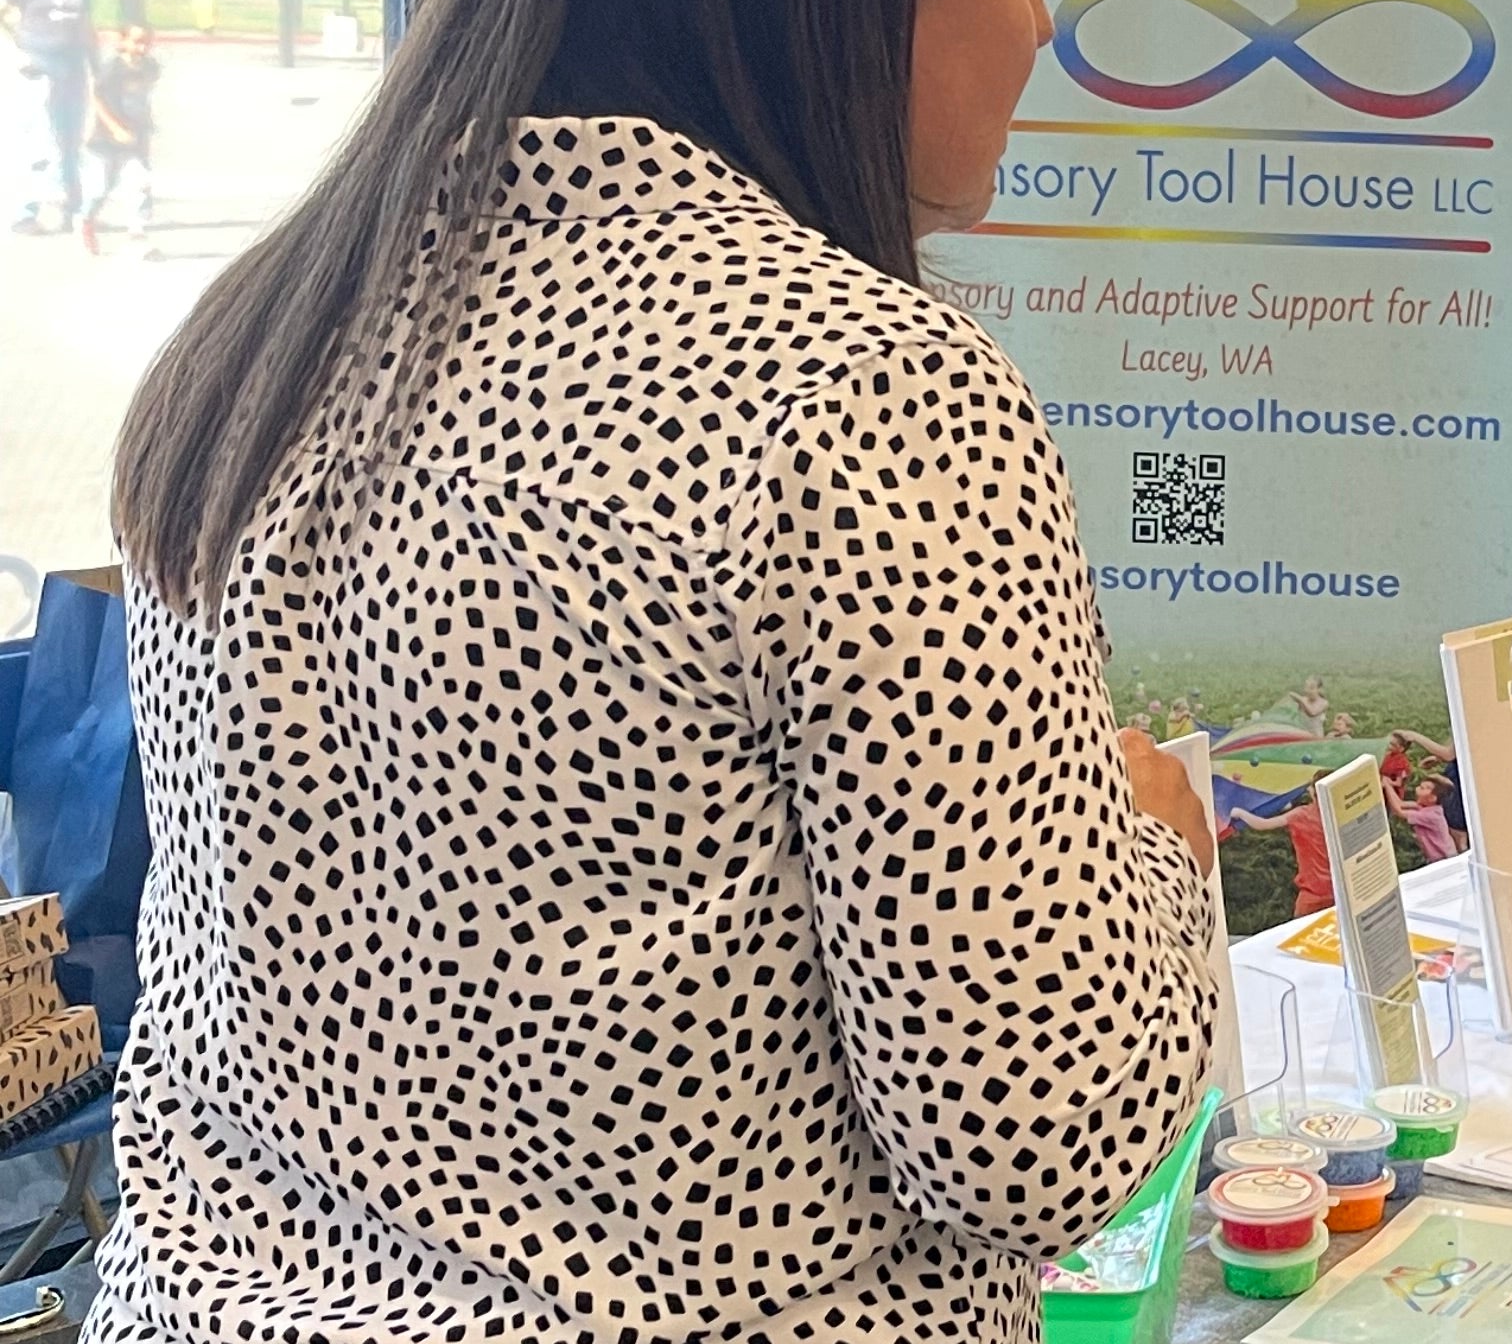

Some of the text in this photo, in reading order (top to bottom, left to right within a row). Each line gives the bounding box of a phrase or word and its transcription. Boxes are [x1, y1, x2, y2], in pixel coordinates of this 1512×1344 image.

[1136, 148, 1235, 204] Tool
[1260, 154, 1414, 211] House
[1435, 178, 1494, 215] LLC
[1026, 276, 1088, 313] and
[1095, 277, 1238, 326] Adaptive
[1248, 283, 1375, 327] Support
[1388, 287, 1432, 326] for
[1439, 289, 1493, 329] All!
[1121, 339, 1273, 382] Lacey, WA
